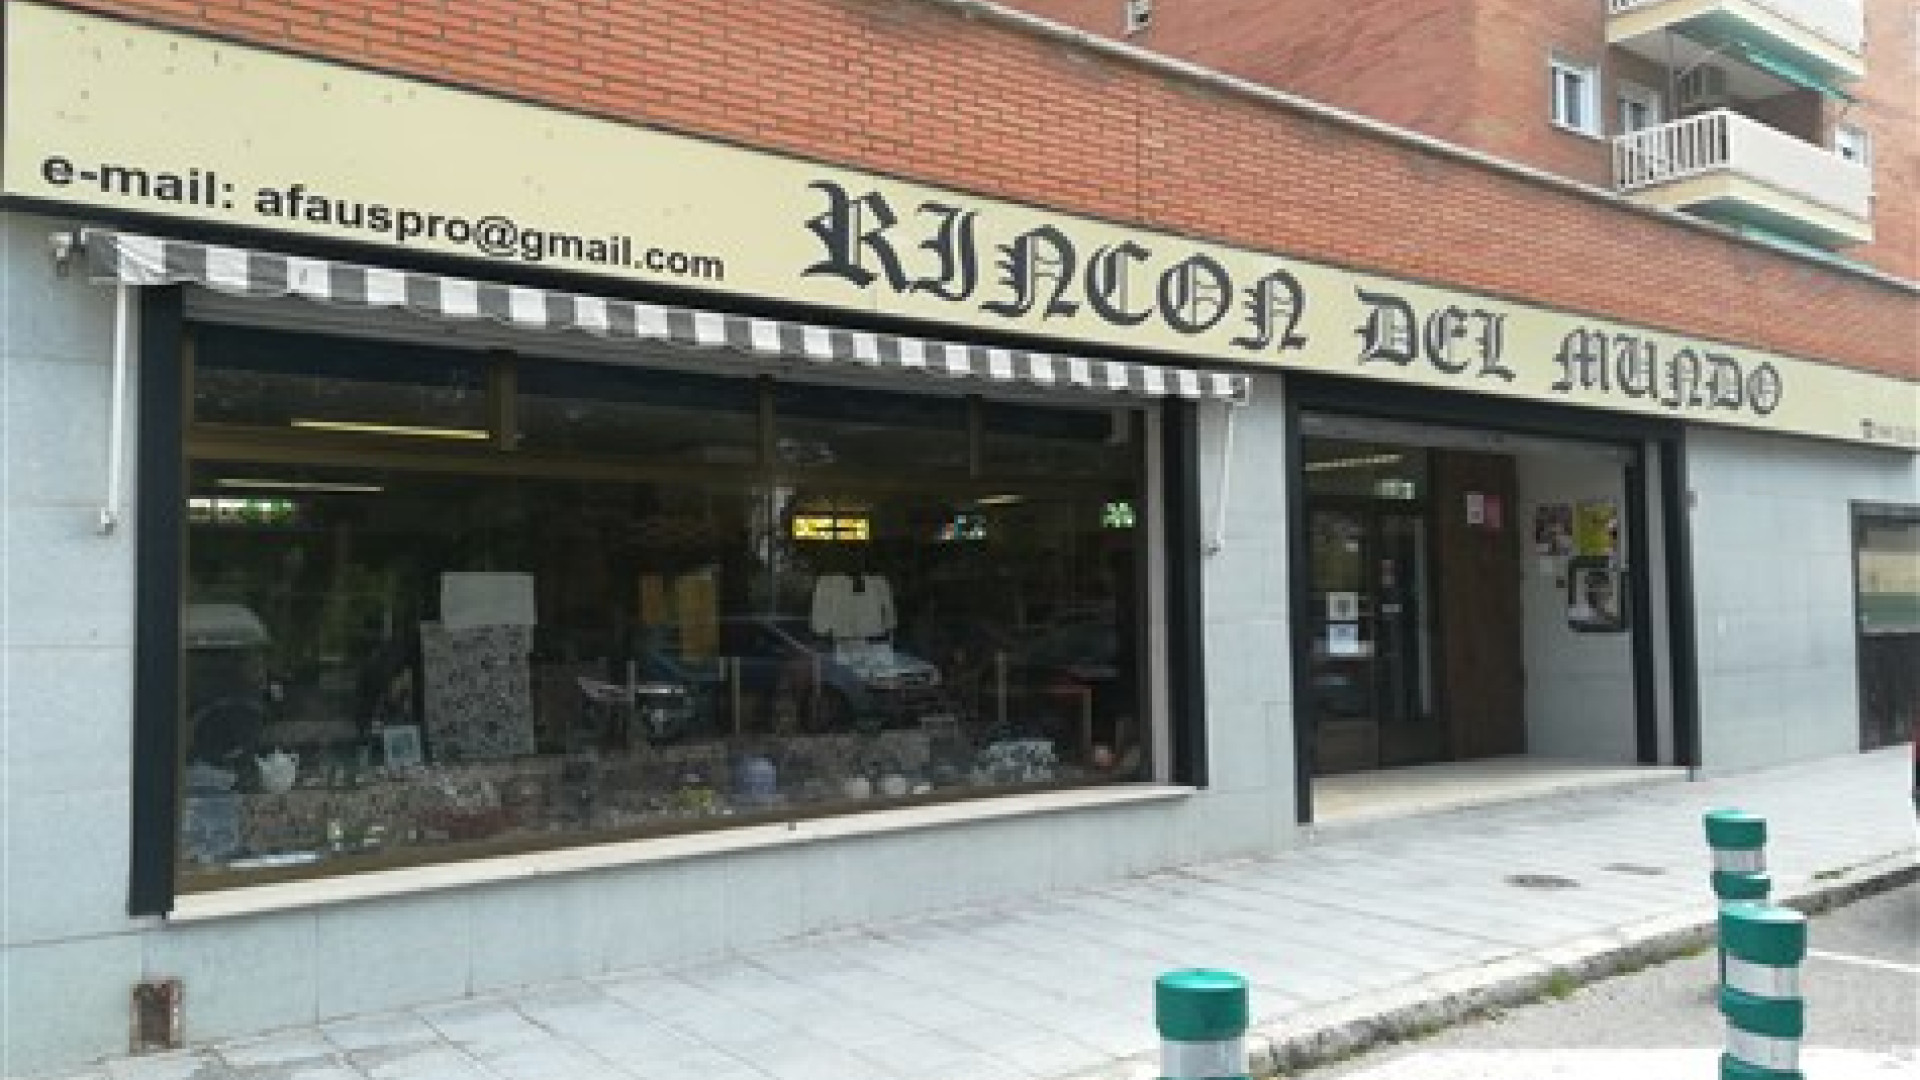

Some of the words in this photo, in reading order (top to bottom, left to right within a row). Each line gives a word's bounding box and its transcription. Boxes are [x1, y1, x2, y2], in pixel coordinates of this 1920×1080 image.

[41, 152, 237, 210] e-mail:
[254, 182, 726, 282] afauspro@gmail.com
[801, 179, 1309, 351] RINCON
[1353, 286, 1516, 383] DEL
[1551, 326, 1783, 415] MUNDO
